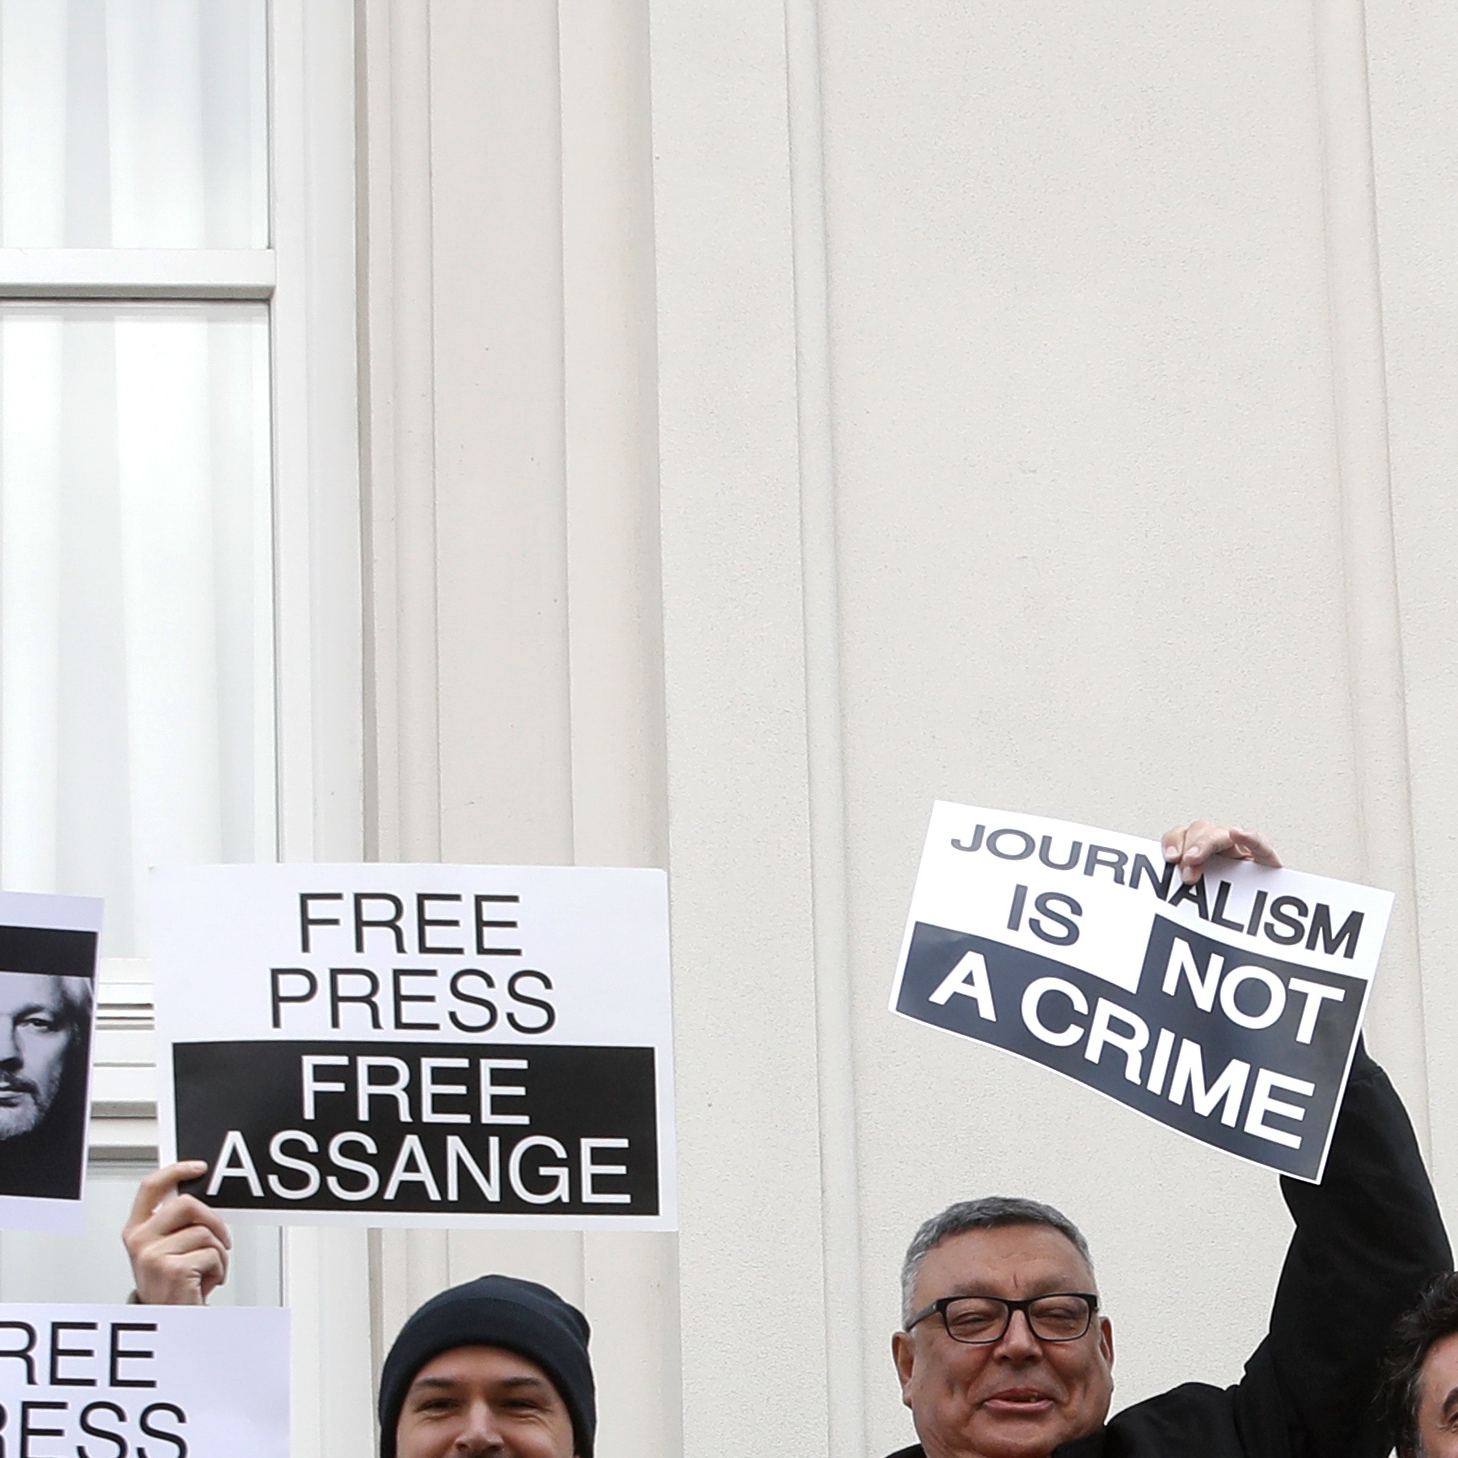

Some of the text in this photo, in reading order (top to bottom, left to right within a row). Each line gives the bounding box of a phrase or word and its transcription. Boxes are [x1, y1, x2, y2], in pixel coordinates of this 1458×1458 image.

[297, 892, 523, 956] FREE
[950, 823, 1365, 960] JOURNALISM
[270, 967, 556, 1034] PRESS
[1006, 883, 1345, 1045] IS NOT
[928, 950, 1316, 1150] A CRIME
[301, 1054, 530, 1125] FREE
[206, 1130, 631, 1204] ASSANGE
